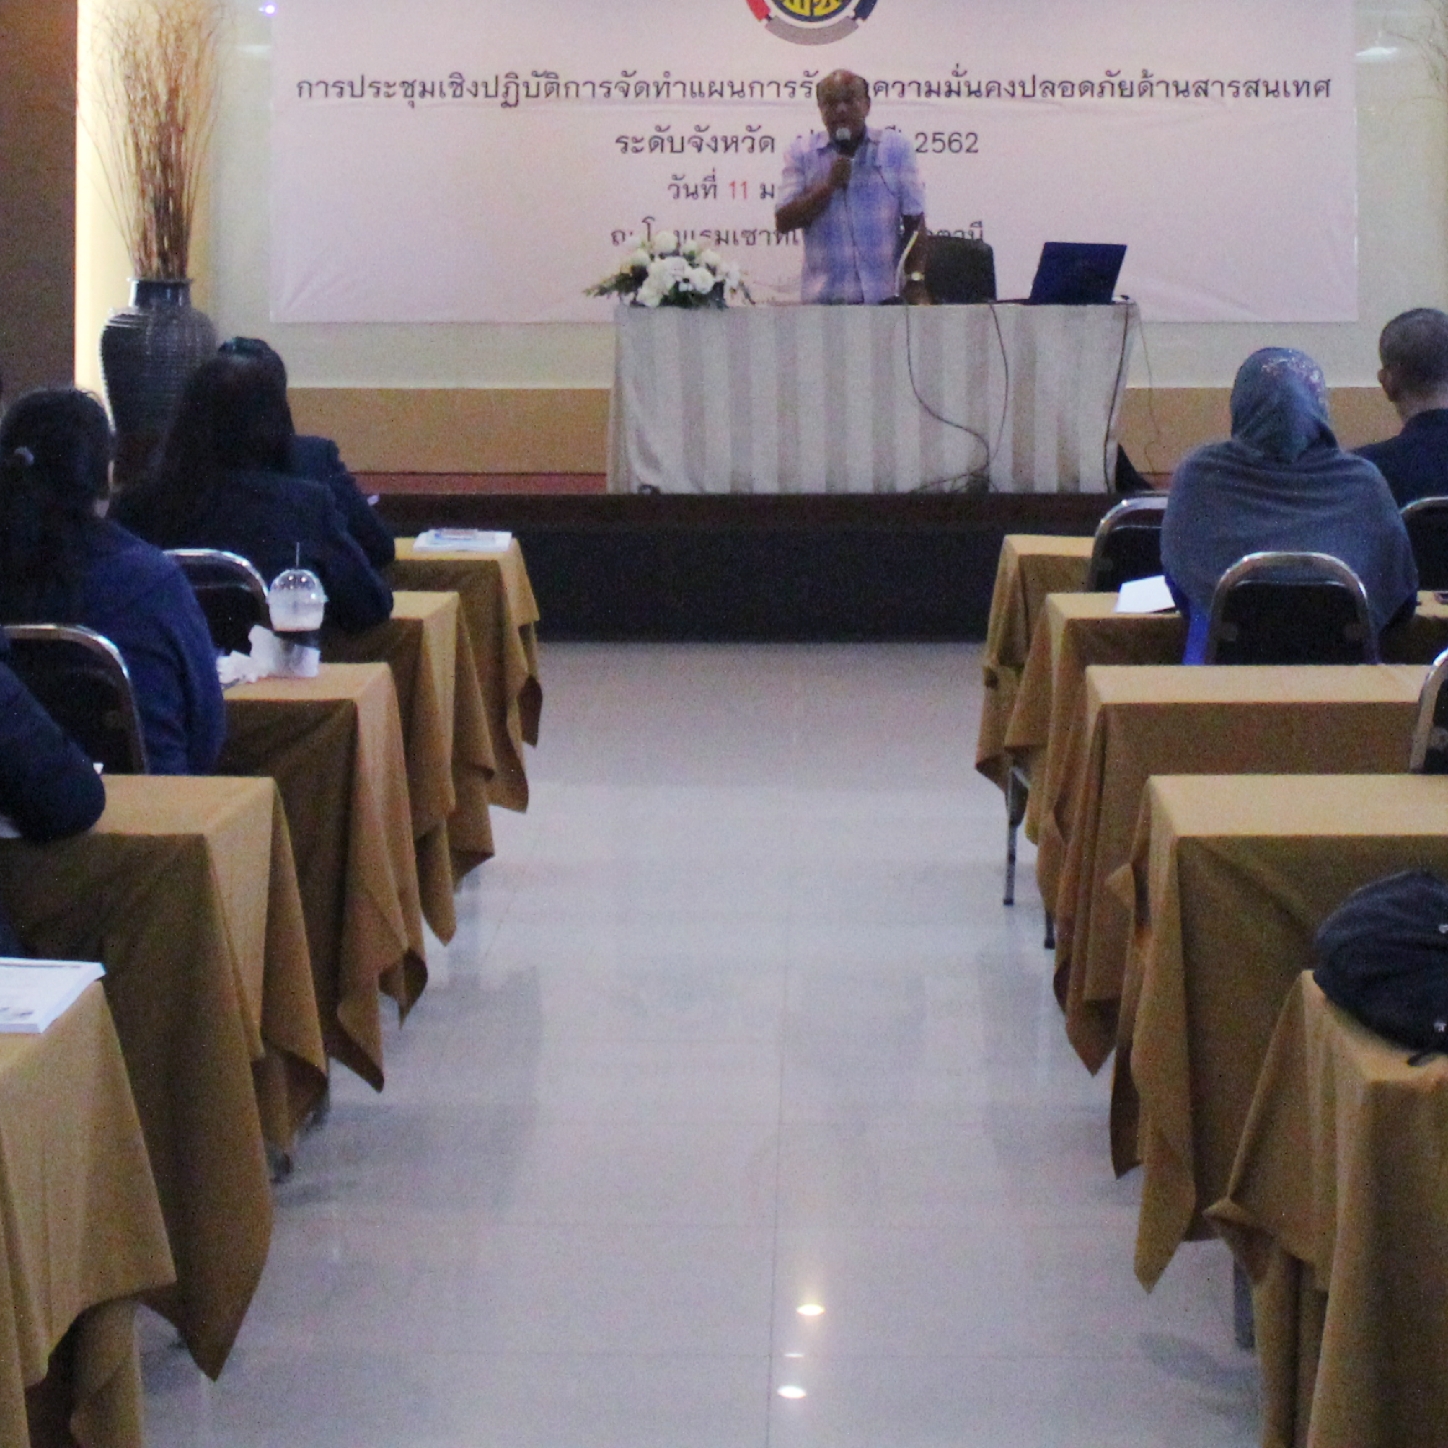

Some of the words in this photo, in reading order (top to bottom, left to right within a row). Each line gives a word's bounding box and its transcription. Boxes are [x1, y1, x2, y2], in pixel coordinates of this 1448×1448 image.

[296, 63, 1332, 108] การประชุมเชิงปฏิบัติการจัดทำแผนการรัความมั่นคงปลอดภัยด้านสารสนเทศ
[615, 124, 776, 154] ระดับจังหวัด
[914, 131, 980, 154] 2562
[667, 167, 719, 200] วันที่
[728, 180, 749, 200] 11
